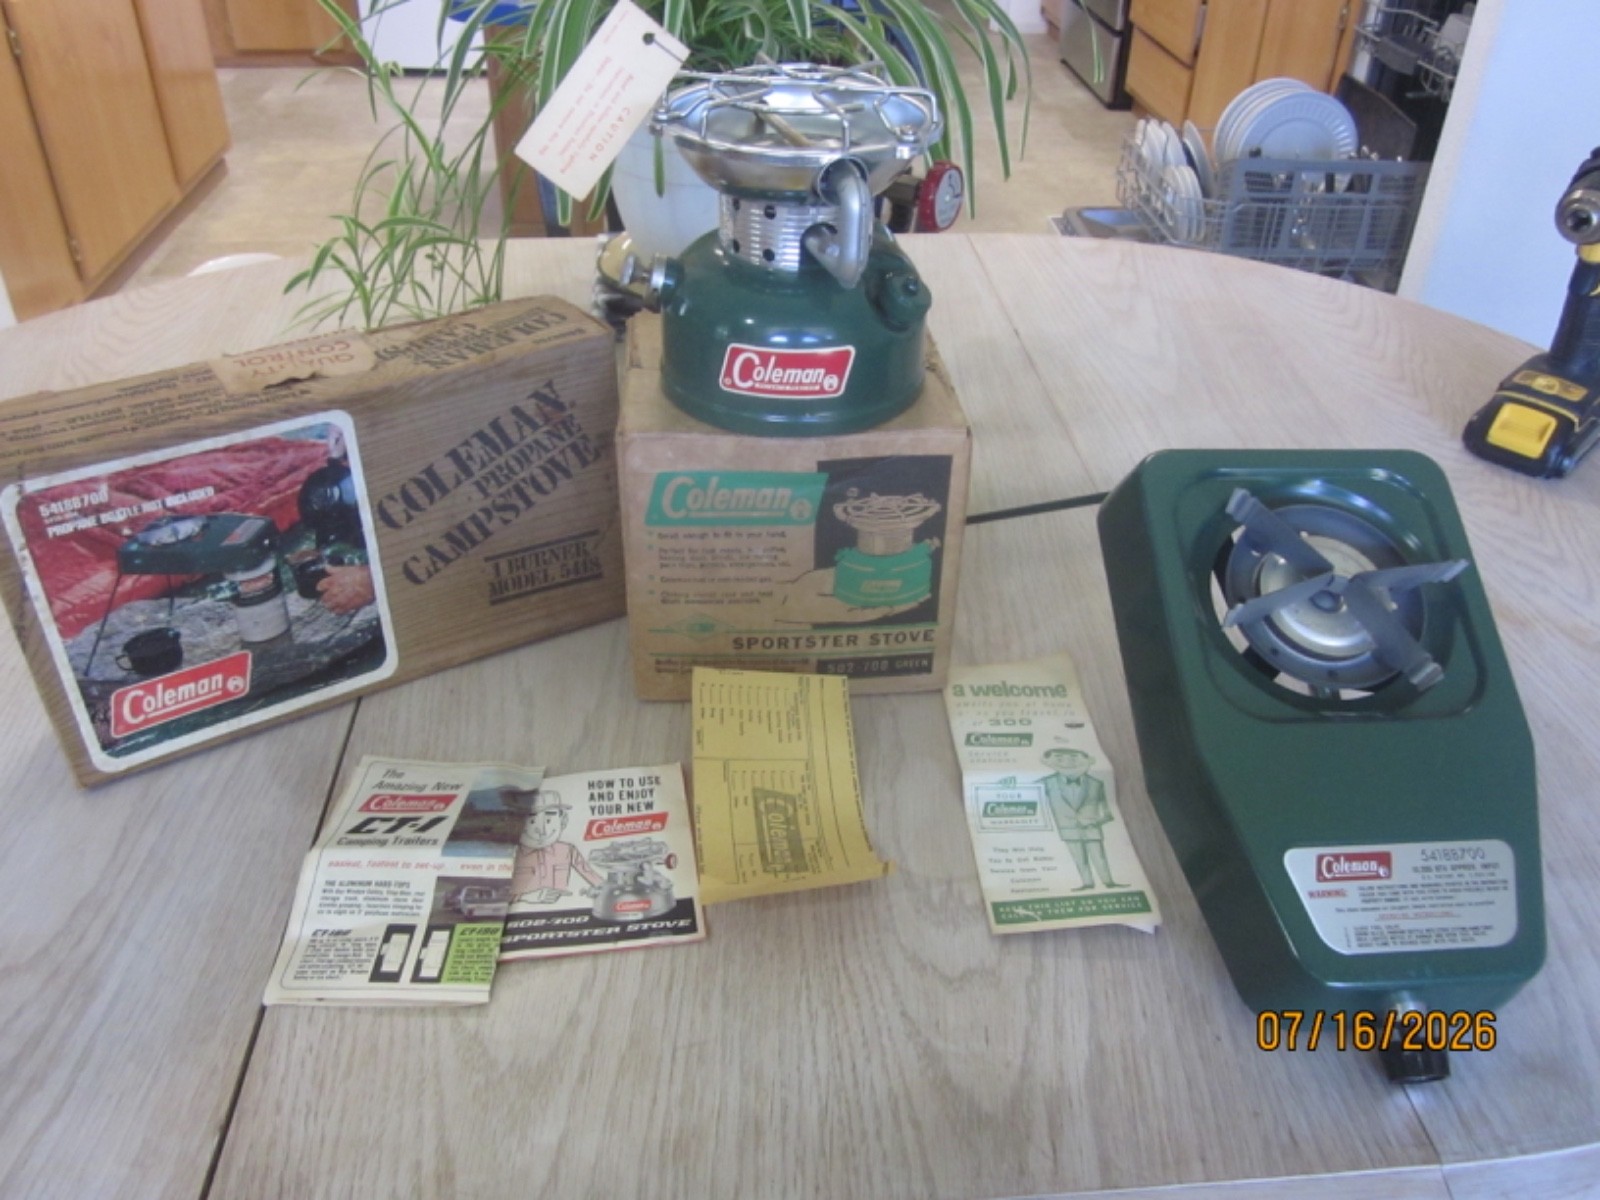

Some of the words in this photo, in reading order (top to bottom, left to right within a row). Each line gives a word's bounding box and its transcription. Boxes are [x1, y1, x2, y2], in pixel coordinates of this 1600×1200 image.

[590, 107, 632, 161] CAUTION
[733, 352, 826, 389] Coleman
[377, 379, 568, 530] COLEMAN
[472, 413, 582, 498] PROPANE
[662, 475, 792, 519] Coleman
[402, 433, 601, 585] CAMPSTOVE
[508, 541, 591, 576] BURNER
[489, 567, 556, 597] MODEL
[731, 633, 858, 651] SPORTSTER
[869, 629, 935, 646] STOVE
[123, 673, 223, 723] Coleman
[952, 684, 965, 697] a
[969, 680, 1068, 698] welcome
[989, 717, 1032, 727] 300
[382, 768, 405, 779] The
[587, 780, 615, 790] HOW
[619, 778, 634, 788] TO
[639, 776, 661, 787] USE
[371, 781, 429, 792] Amazing
[431, 781, 464, 791] New
[588, 792, 614, 802] AND
[619, 788, 654, 801] ENJOY
[370, 795, 438, 810] Coleman
[589, 803, 622, 816] YOUR
[627, 801, 654, 813] NEW
[592, 819, 652, 838] Coleman
[336, 837, 389, 848] Camping
[392, 836, 439, 847] Trailers
[1321, 855, 1377, 879] Coleman
[502, 926, 620, 944] SPORTSTER
[626, 919, 693, 933] STOVE
